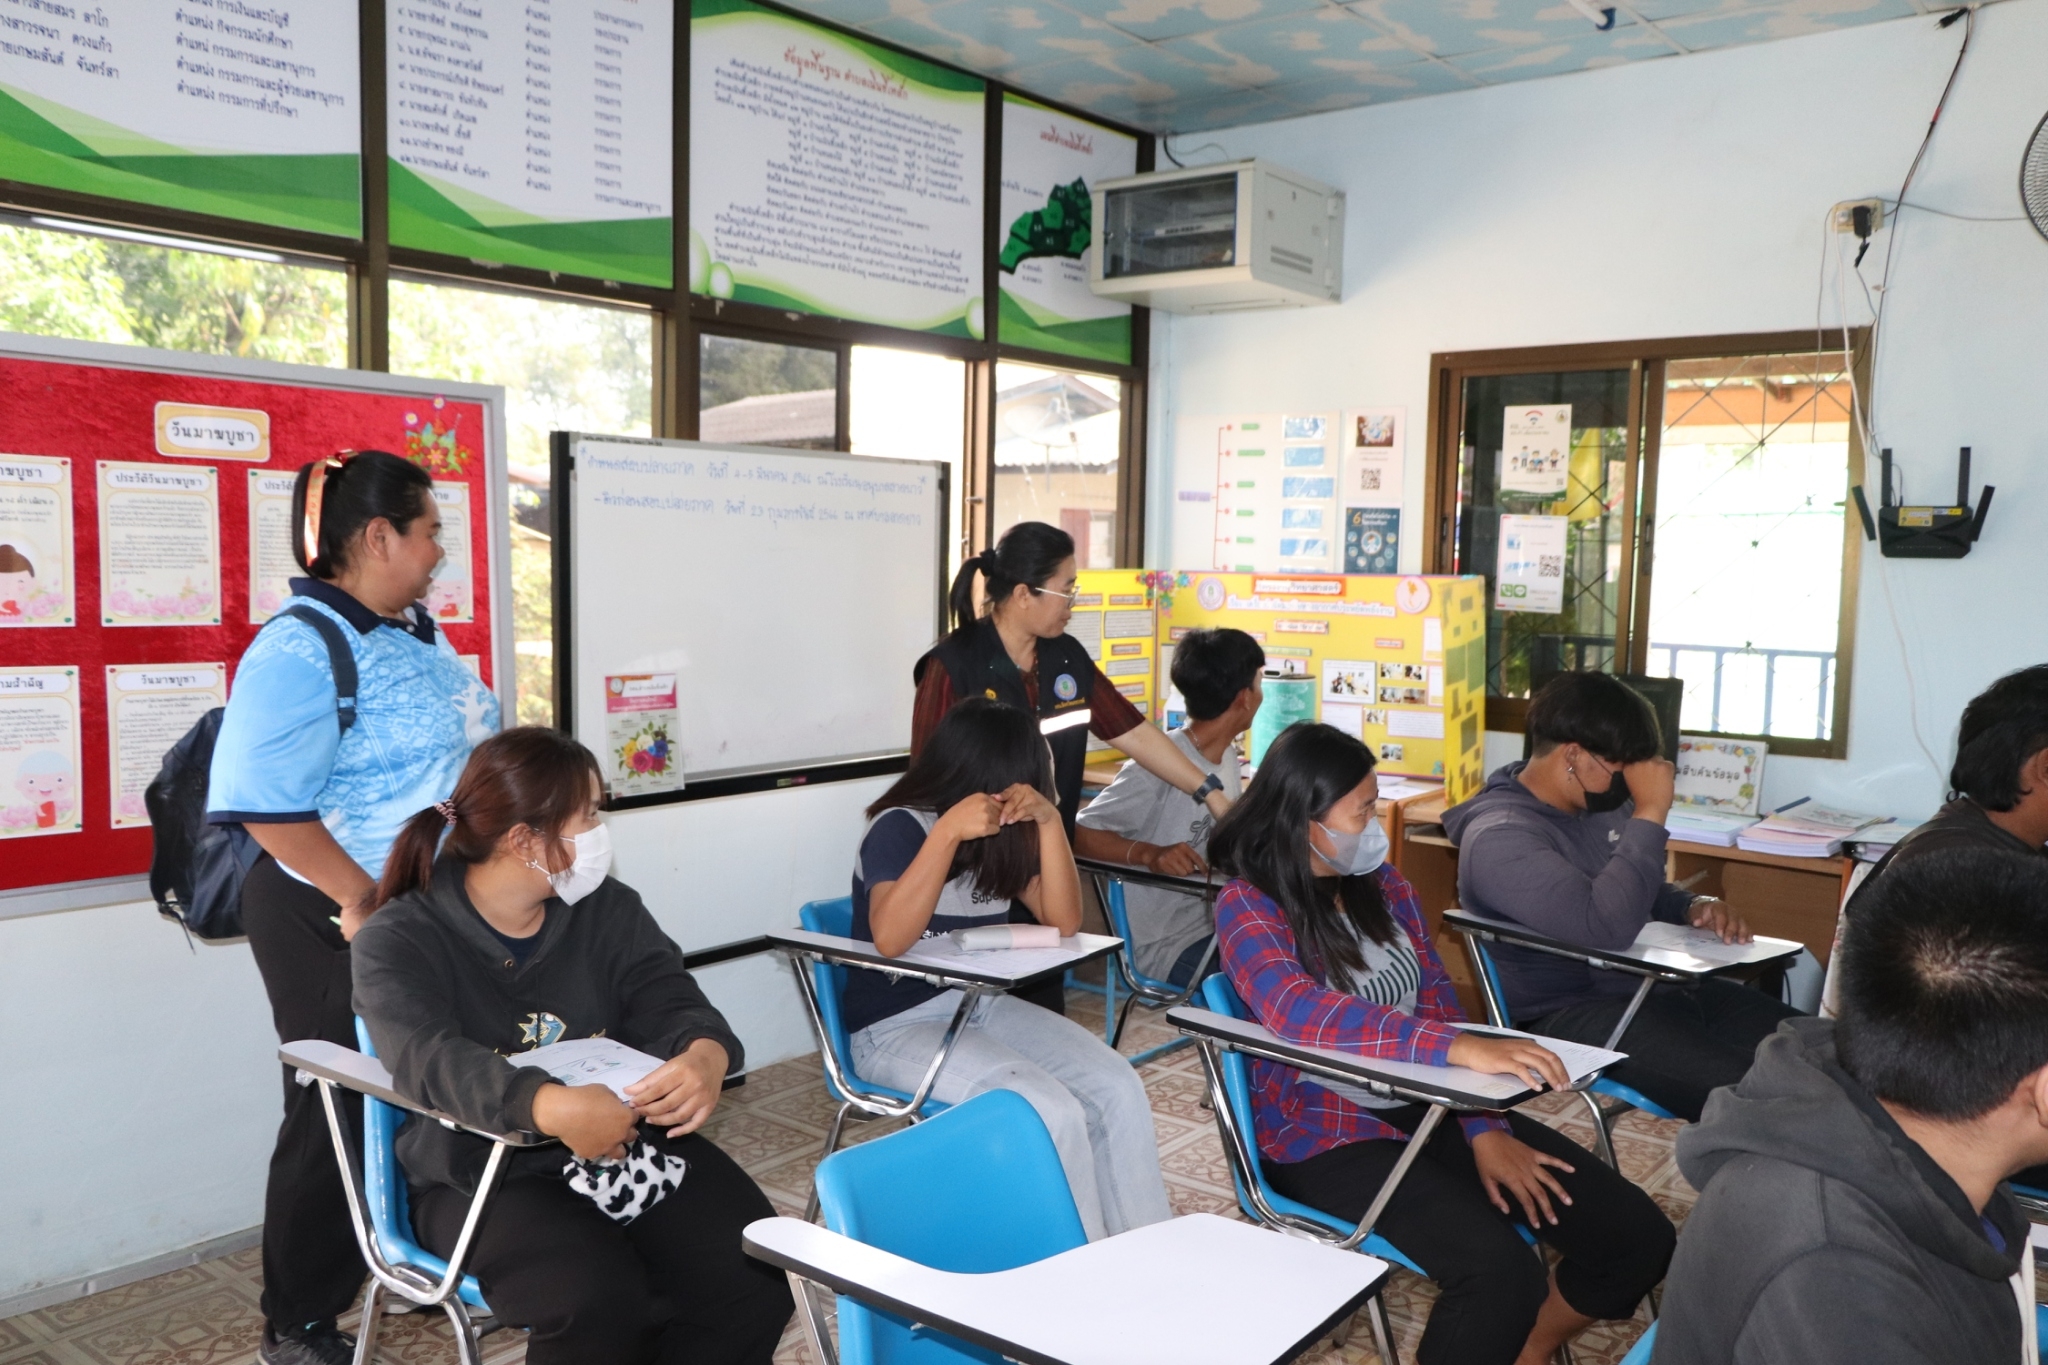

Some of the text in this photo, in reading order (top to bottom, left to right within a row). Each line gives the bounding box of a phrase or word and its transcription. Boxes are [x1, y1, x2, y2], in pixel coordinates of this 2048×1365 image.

[0, 14, 60, 40] างสาวรจนา
[175, 8, 214, 31] ตำแหน่ง
[0, 40, 65, 66] ายเกษมสันต์
[176, 55, 215, 78] ตำแหน่ง
[176, 79, 216, 101] ตำแหน่ง
[172, 421, 255, 446] วันมาฆบูชา
[0, 466, 43, 481] าฆบูชา
[115, 472, 203, 489] ประวัติวันมาฆบูชา
[1352, 511, 1361, 525] 6
[0, 677, 44, 690] ามสำคัญ
[141, 674, 196, 687] วันมาฆบูชา
